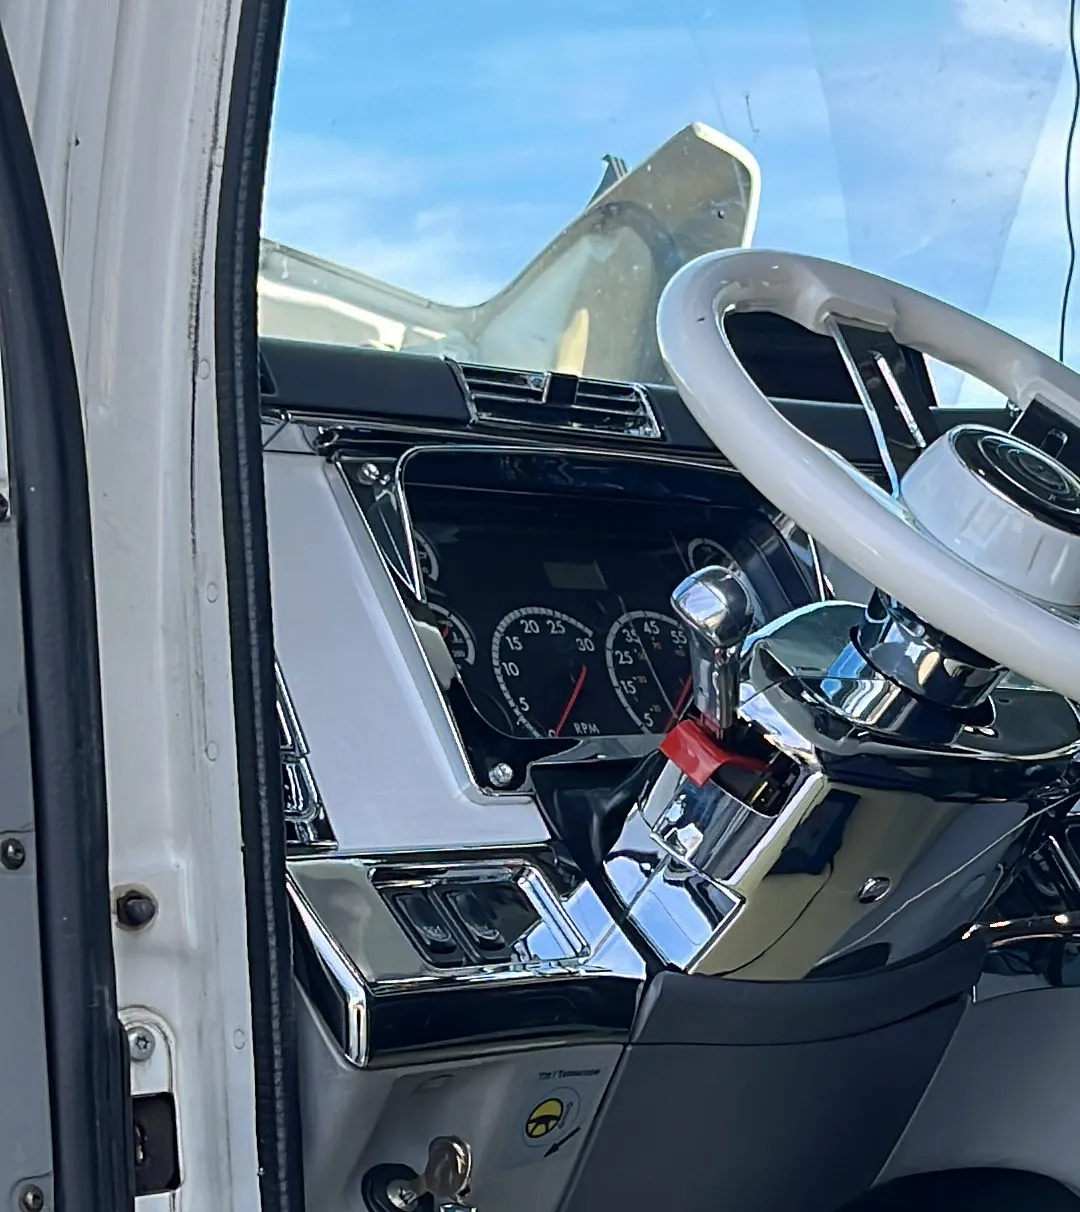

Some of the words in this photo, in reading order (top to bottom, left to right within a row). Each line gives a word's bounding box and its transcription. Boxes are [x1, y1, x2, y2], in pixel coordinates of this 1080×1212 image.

[520, 620, 540, 634] 20
[546, 620, 566, 634] 25
[643, 620, 660, 635] 45
[505, 636, 524, 651] 15
[622, 629, 640, 643] 35
[670, 630, 688, 645] 55
[575, 638, 595, 652] 30
[614, 650, 634, 665] 25
[501, 662, 520, 677] 10
[619, 680, 637, 695] 15
[519, 697, 530, 712] 5
[643, 712, 654, 728] 5
[573, 722, 601, 734] RPM
